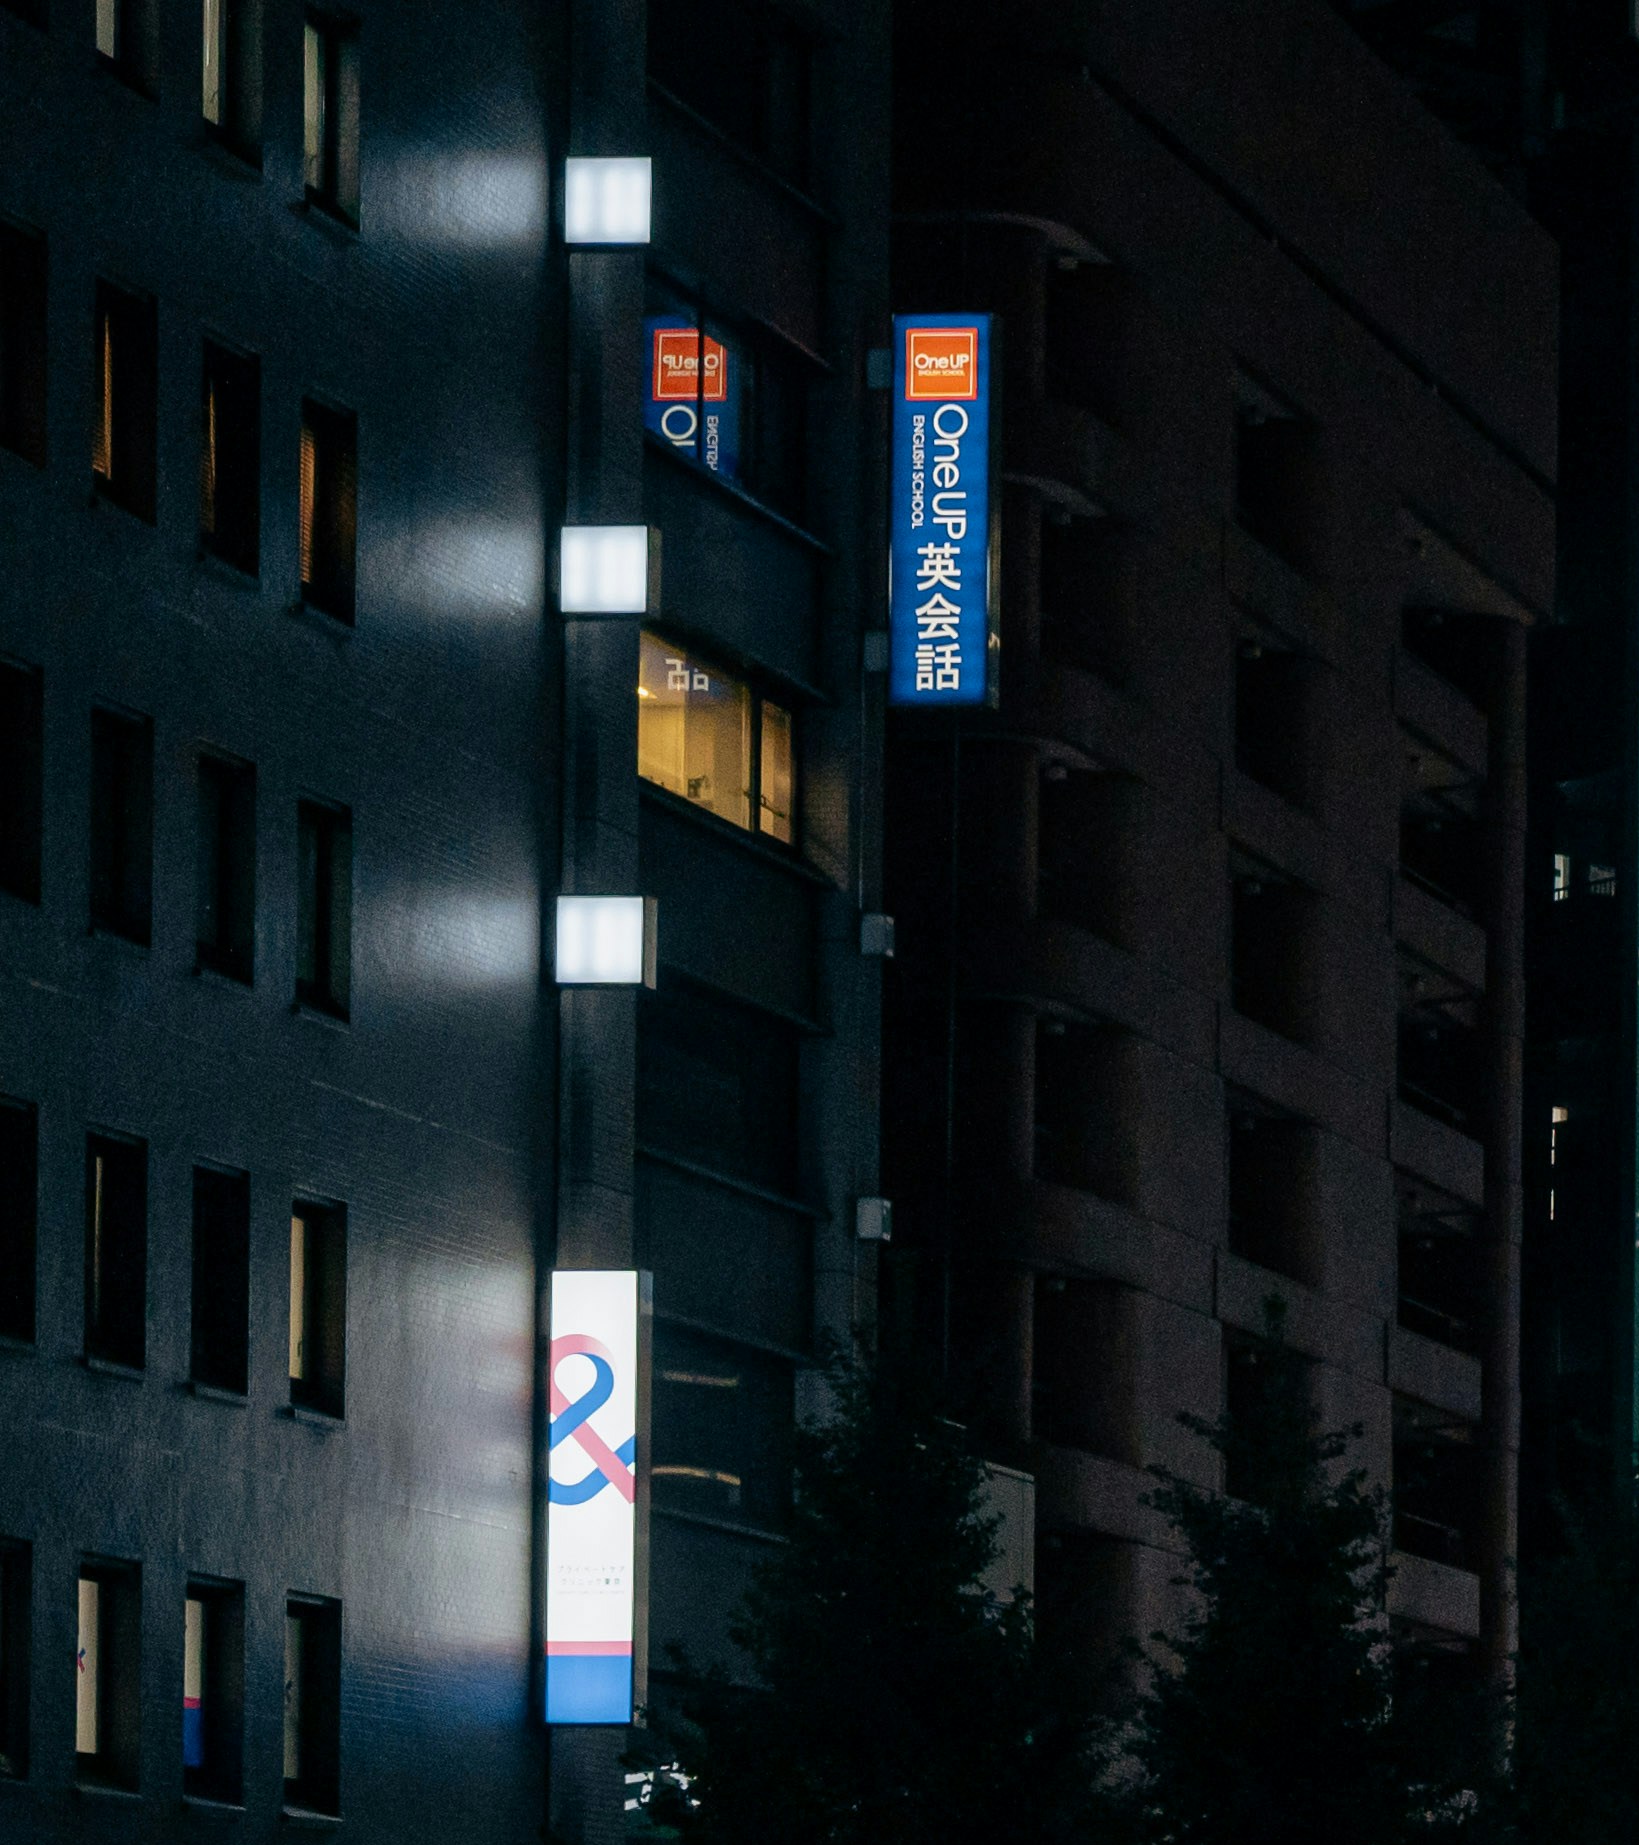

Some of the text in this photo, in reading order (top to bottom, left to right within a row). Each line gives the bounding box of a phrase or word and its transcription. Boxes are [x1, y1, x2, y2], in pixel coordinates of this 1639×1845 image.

[911, 414, 925, 530] ENGLISH SCHOOL
[932, 403, 968, 540] OneUP
[914, 542, 962, 691] 英会話
